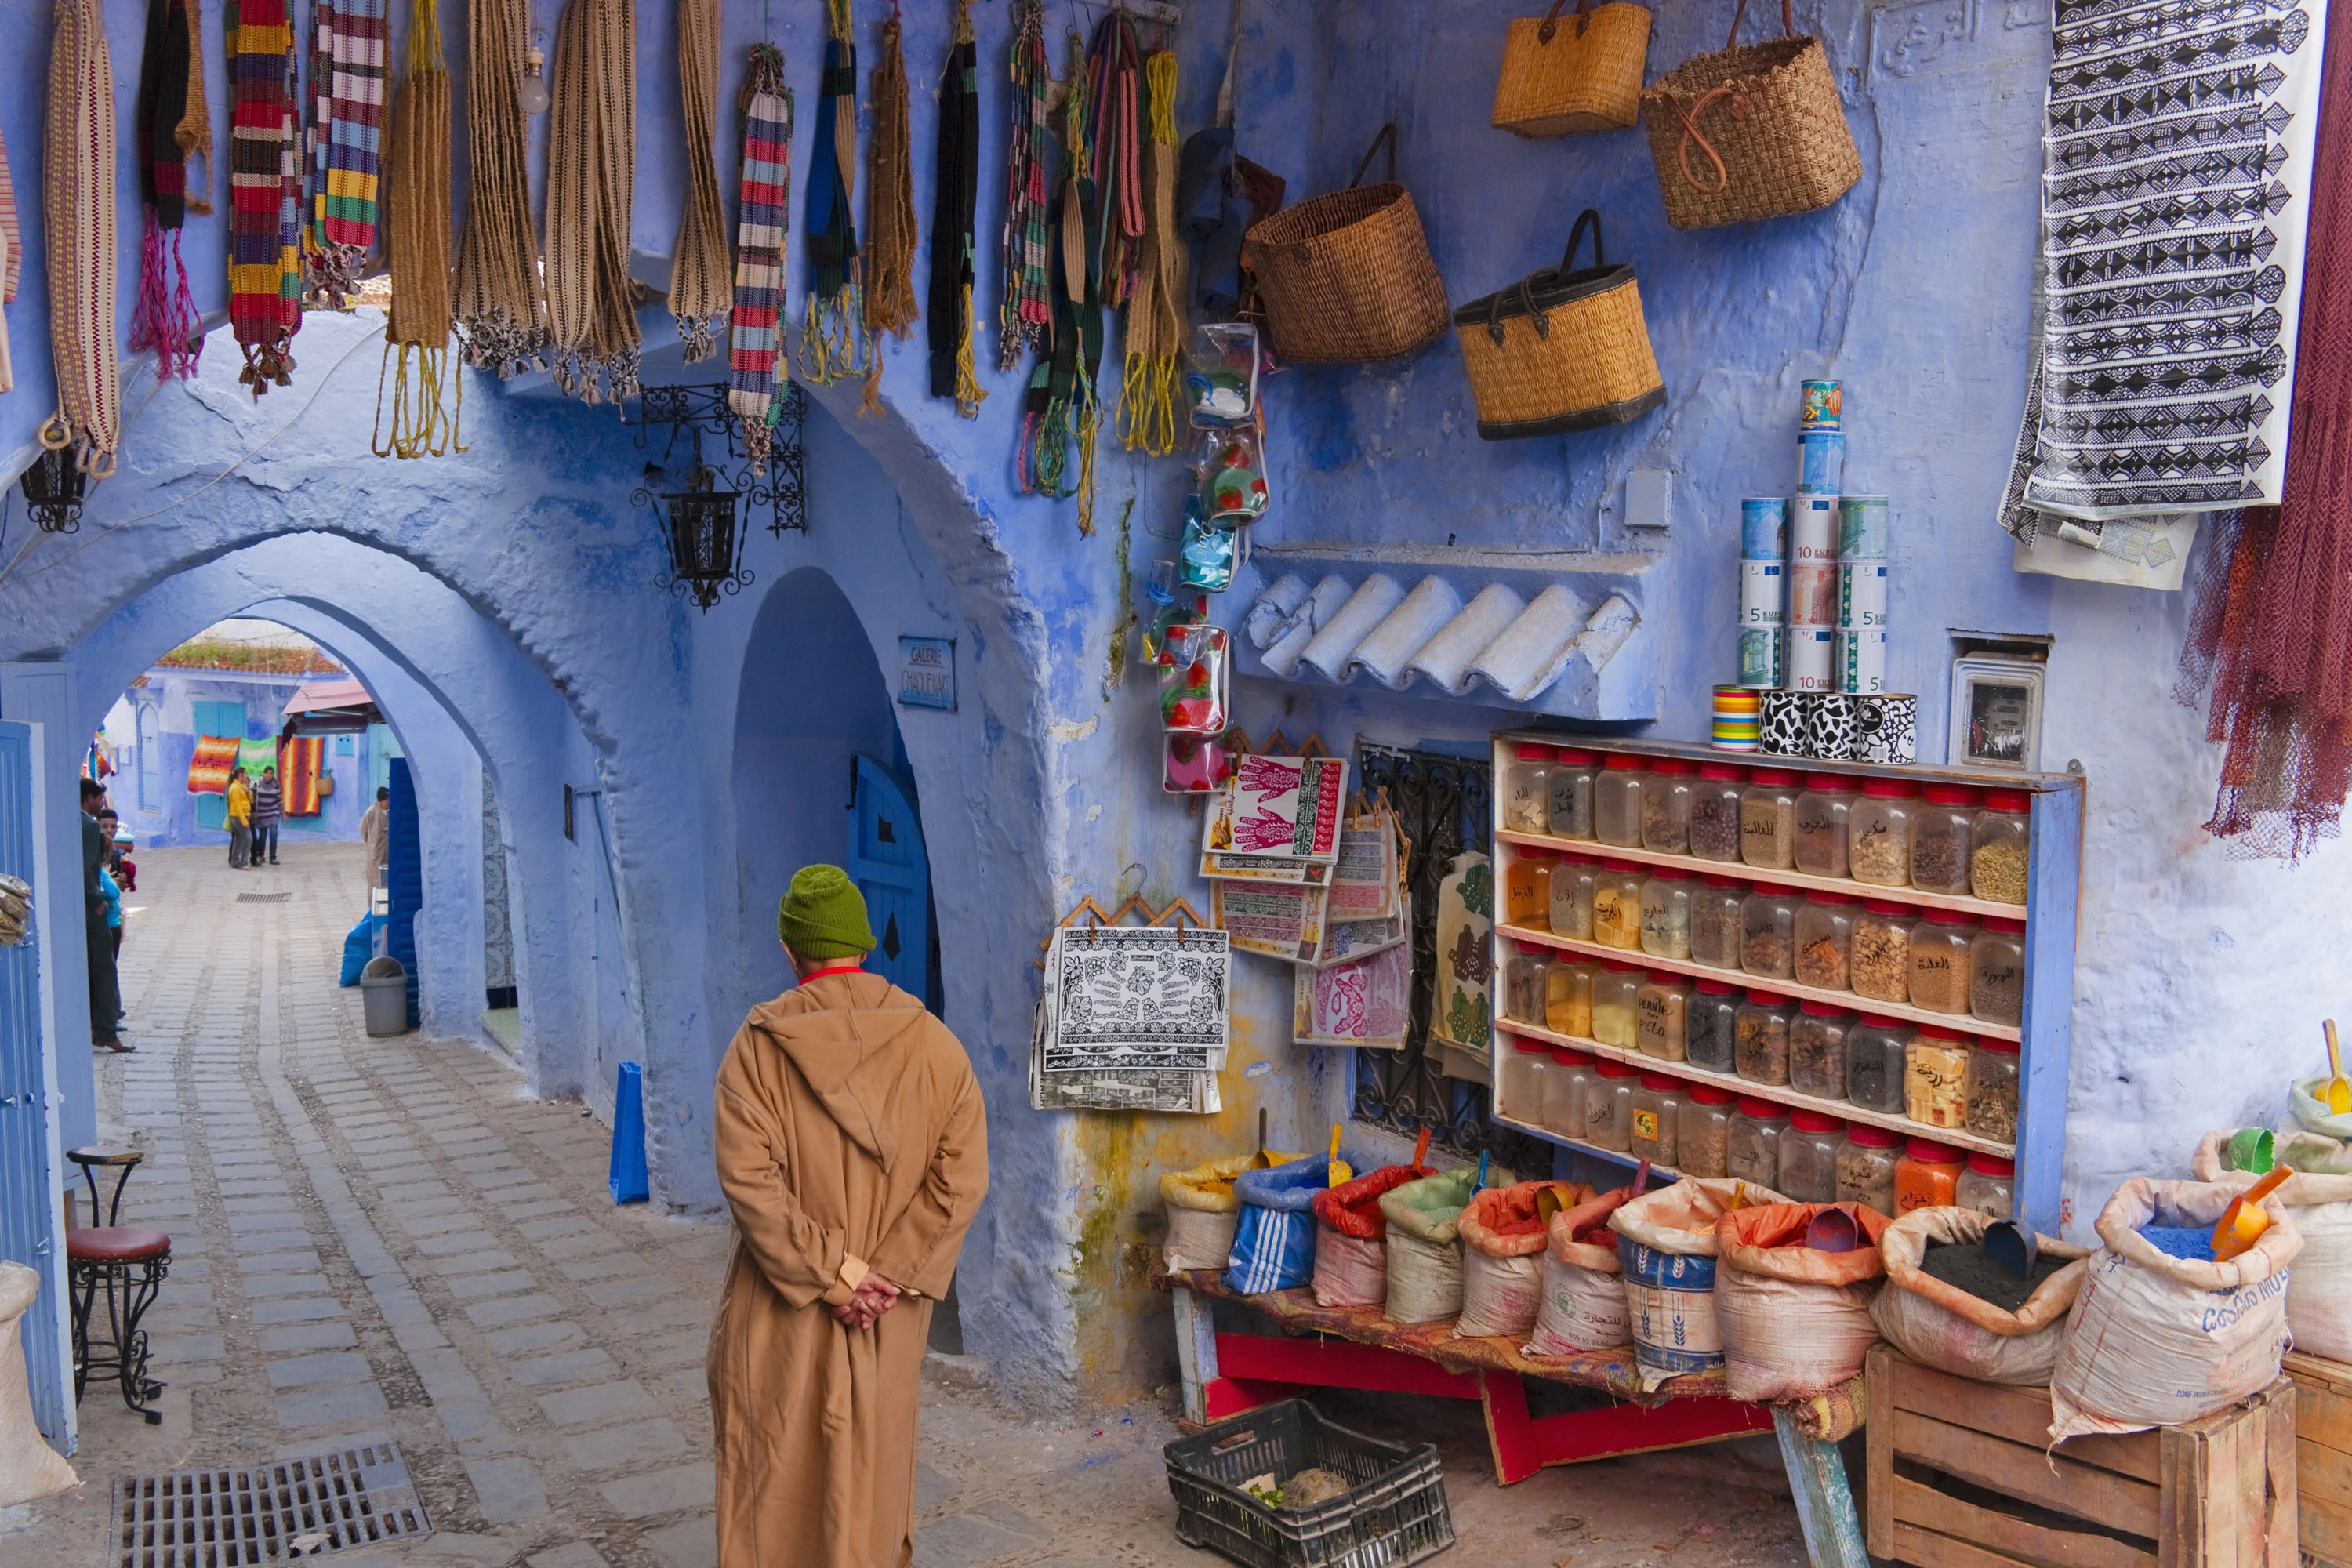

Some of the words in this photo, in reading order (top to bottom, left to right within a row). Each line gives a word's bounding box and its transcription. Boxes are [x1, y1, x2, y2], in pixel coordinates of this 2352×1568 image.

[1798, 546, 1812, 559] 10
[1750, 608, 1760, 622] 5
[1863, 611, 1873, 625] 5
[910, 646, 942, 665] GALERIE
[1799, 676, 1815, 688] 10
[1870, 677, 1878, 691] 5
[1639, 1019, 1664, 1036] PELO
